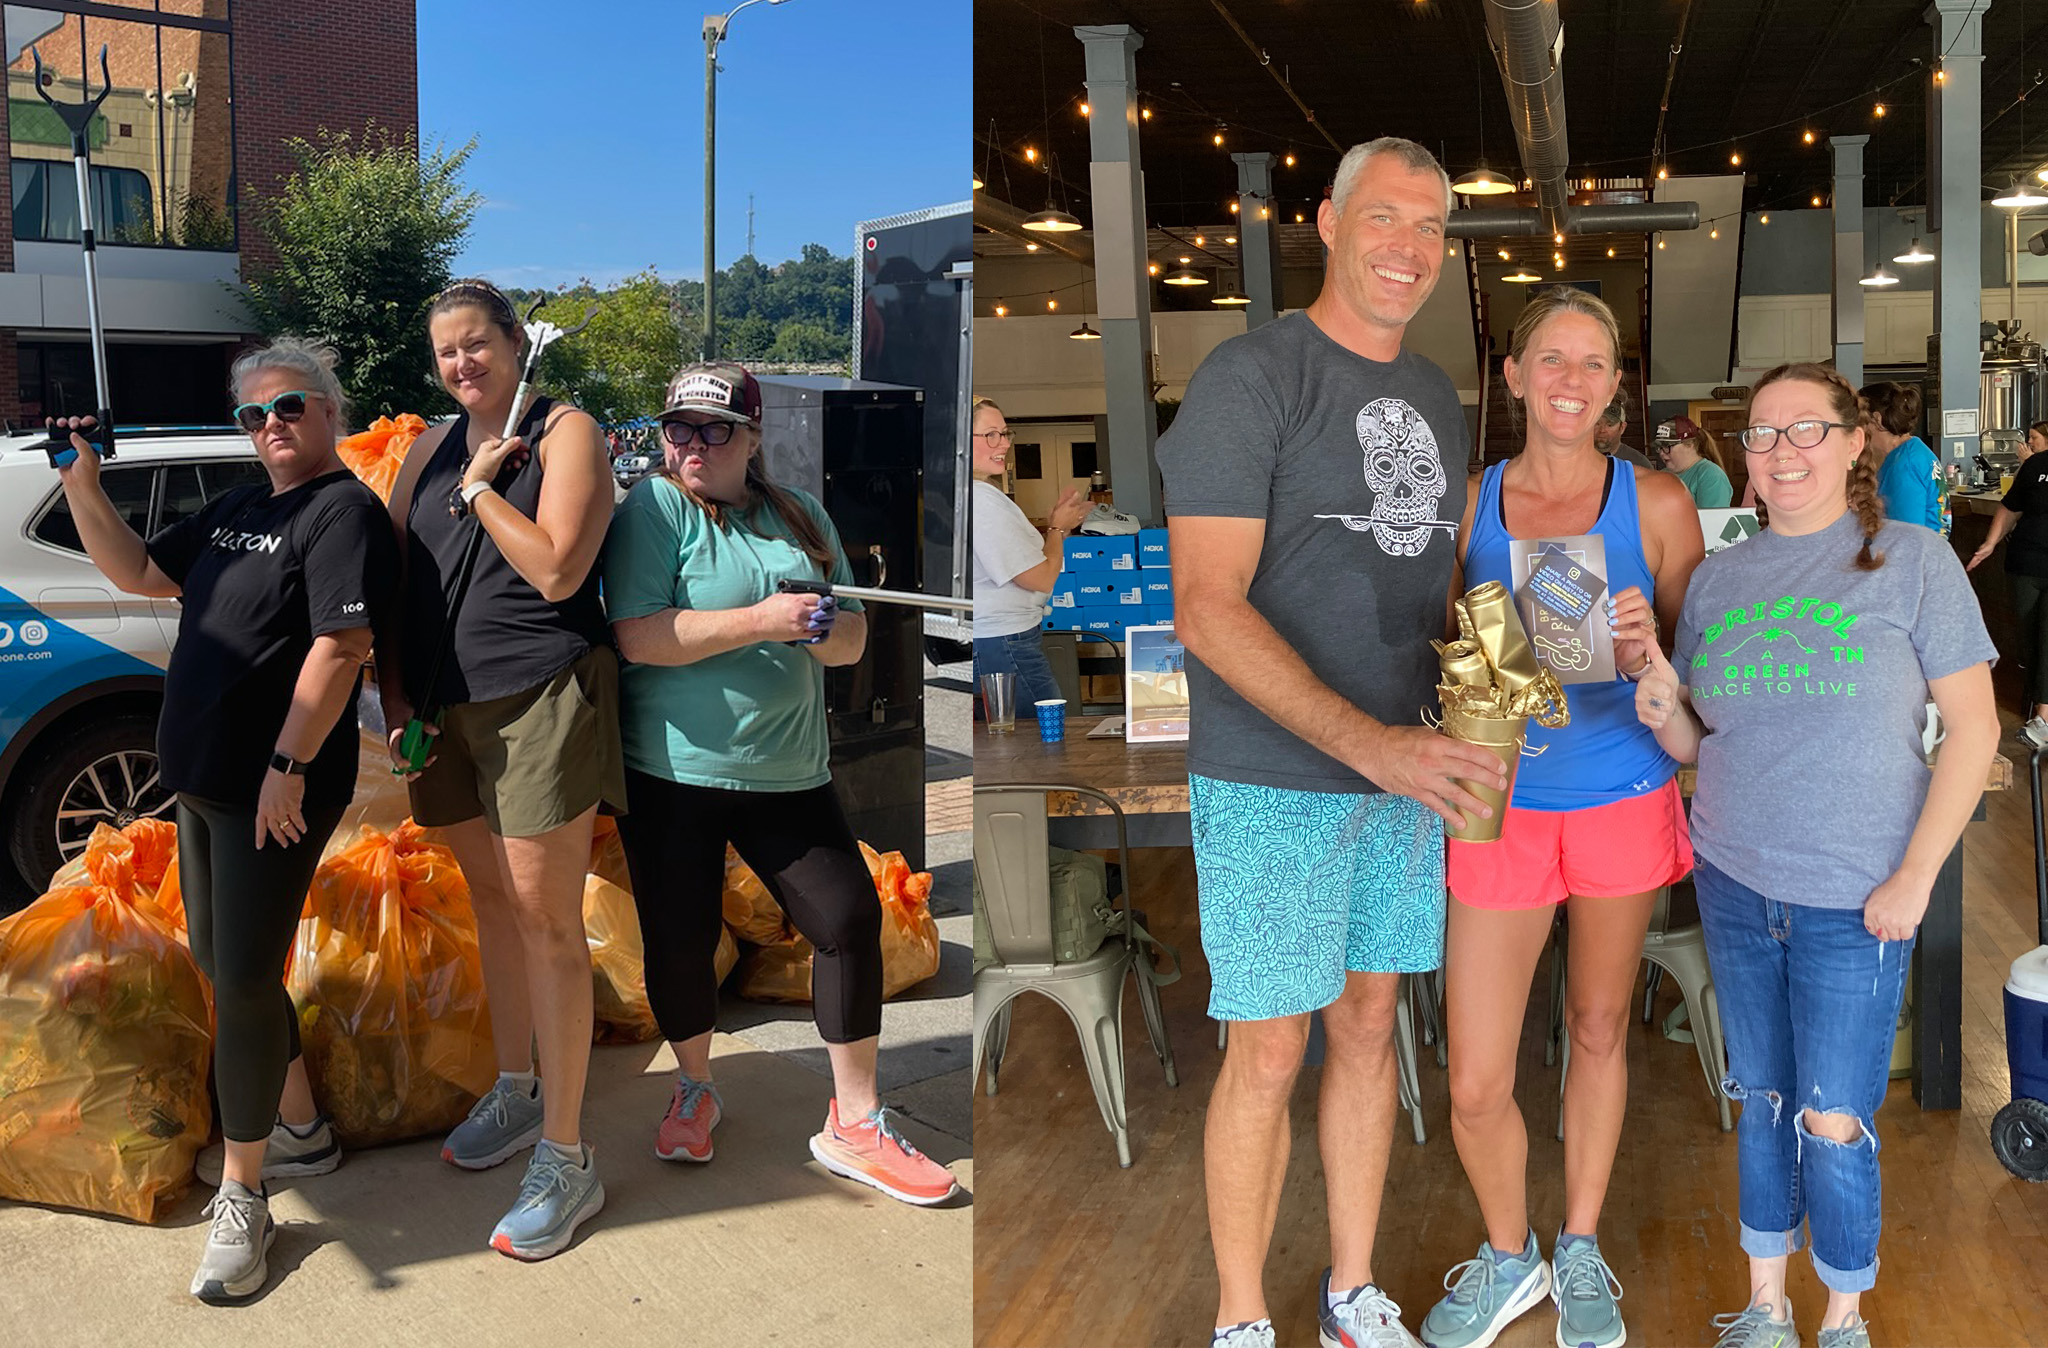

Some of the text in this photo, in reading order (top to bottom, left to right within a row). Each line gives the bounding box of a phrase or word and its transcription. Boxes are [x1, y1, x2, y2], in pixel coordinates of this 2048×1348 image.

[1114, 513, 1130, 522] HOKA
[1538, 568, 1555, 581] VIDEO
[1553, 578, 1562, 586] ON
[1544, 565, 1561, 578] SHARE
[1565, 579, 1584, 593] PHOTO
[1583, 590, 1592, 599] OR
[342, 602, 365, 614] 100
[1705, 596, 1858, 645] BRISTOL
[0, 651, 52, 662] one.com
[1691, 646, 1864, 670] VA TN
[1761, 650, 1774, 660] A
[1724, 663, 1809, 679] GREEN
[1693, 681, 1857, 699] PLACE TO LIVE
